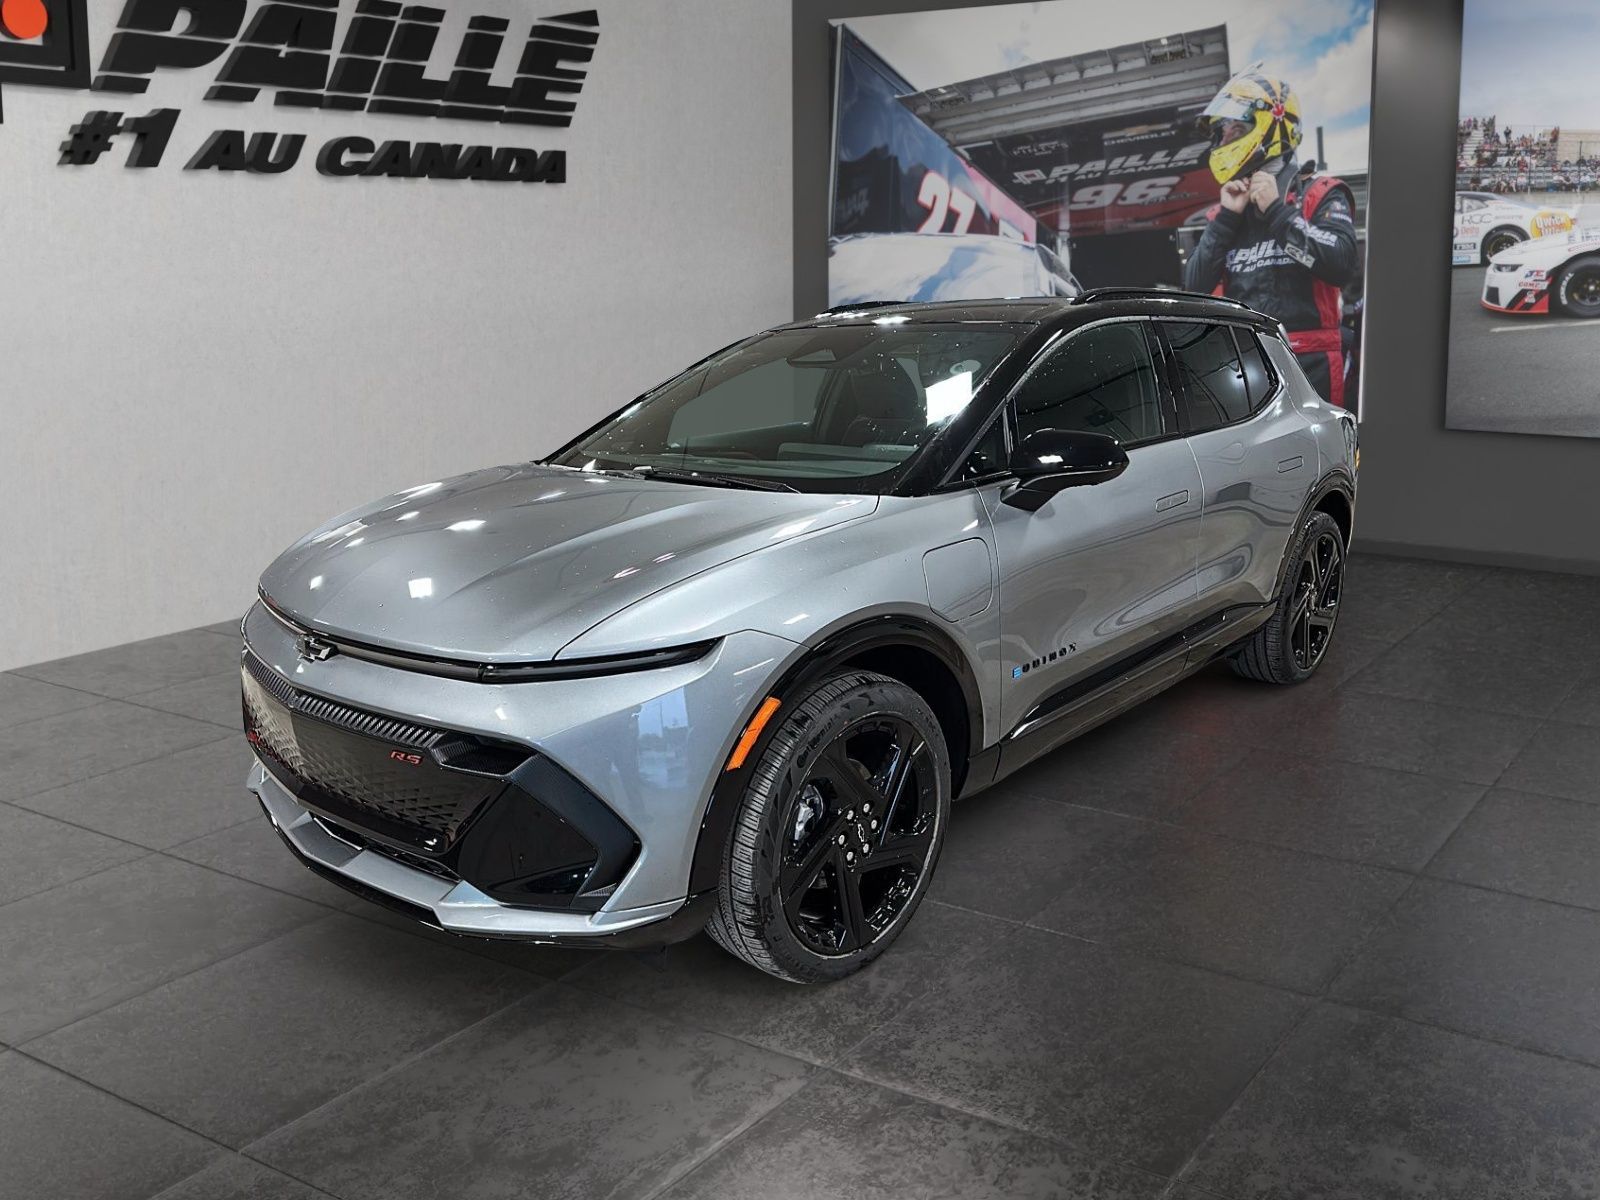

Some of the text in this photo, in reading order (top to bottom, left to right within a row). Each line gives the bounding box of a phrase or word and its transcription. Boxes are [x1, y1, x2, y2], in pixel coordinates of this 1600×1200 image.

[57, 108, 567, 184] #1 AU CANADA
[1073, 171, 1102, 181] AU
[1108, 159, 1199, 176] CANADA
[917, 169, 977, 236] 27
[1068, 176, 1183, 212] 96
[1012, 642, 1077, 679] EQUINOX
[390, 750, 422, 765] RS
